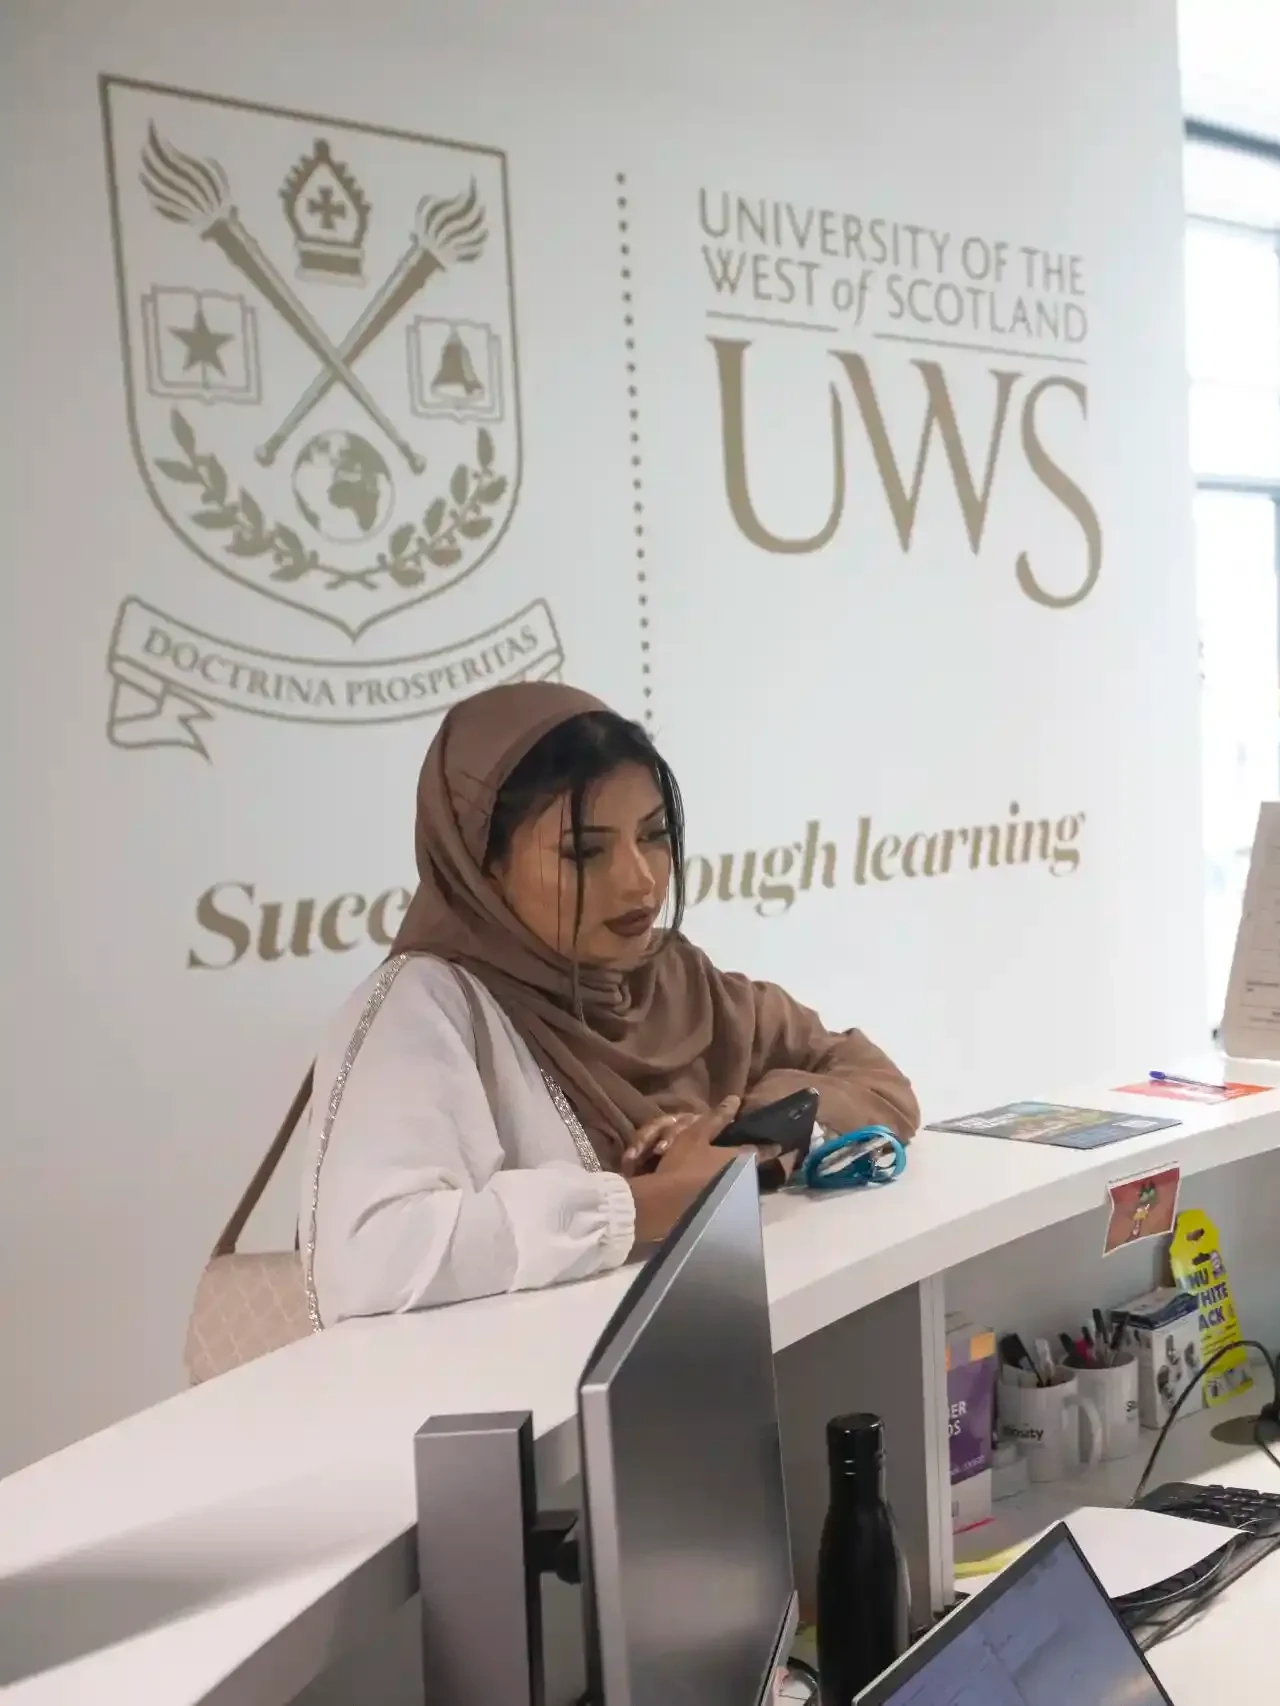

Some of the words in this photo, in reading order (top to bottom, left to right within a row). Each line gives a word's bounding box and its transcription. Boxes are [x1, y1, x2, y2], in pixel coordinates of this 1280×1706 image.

[698, 187, 951, 273] UNIVERSITY
[961, 236, 1009, 281] OF
[1019, 246, 1086, 295] THE
[701, 245, 822, 307] WEST
[833, 269, 874, 325] of
[886, 273, 1089, 344] SCOTLAND
[705, 334, 1103, 609] UWS
[142, 626, 336, 708] DOCTRINA
[345, 625, 539, 708] PROSPERITAS
[853, 801, 1086, 878] learning
